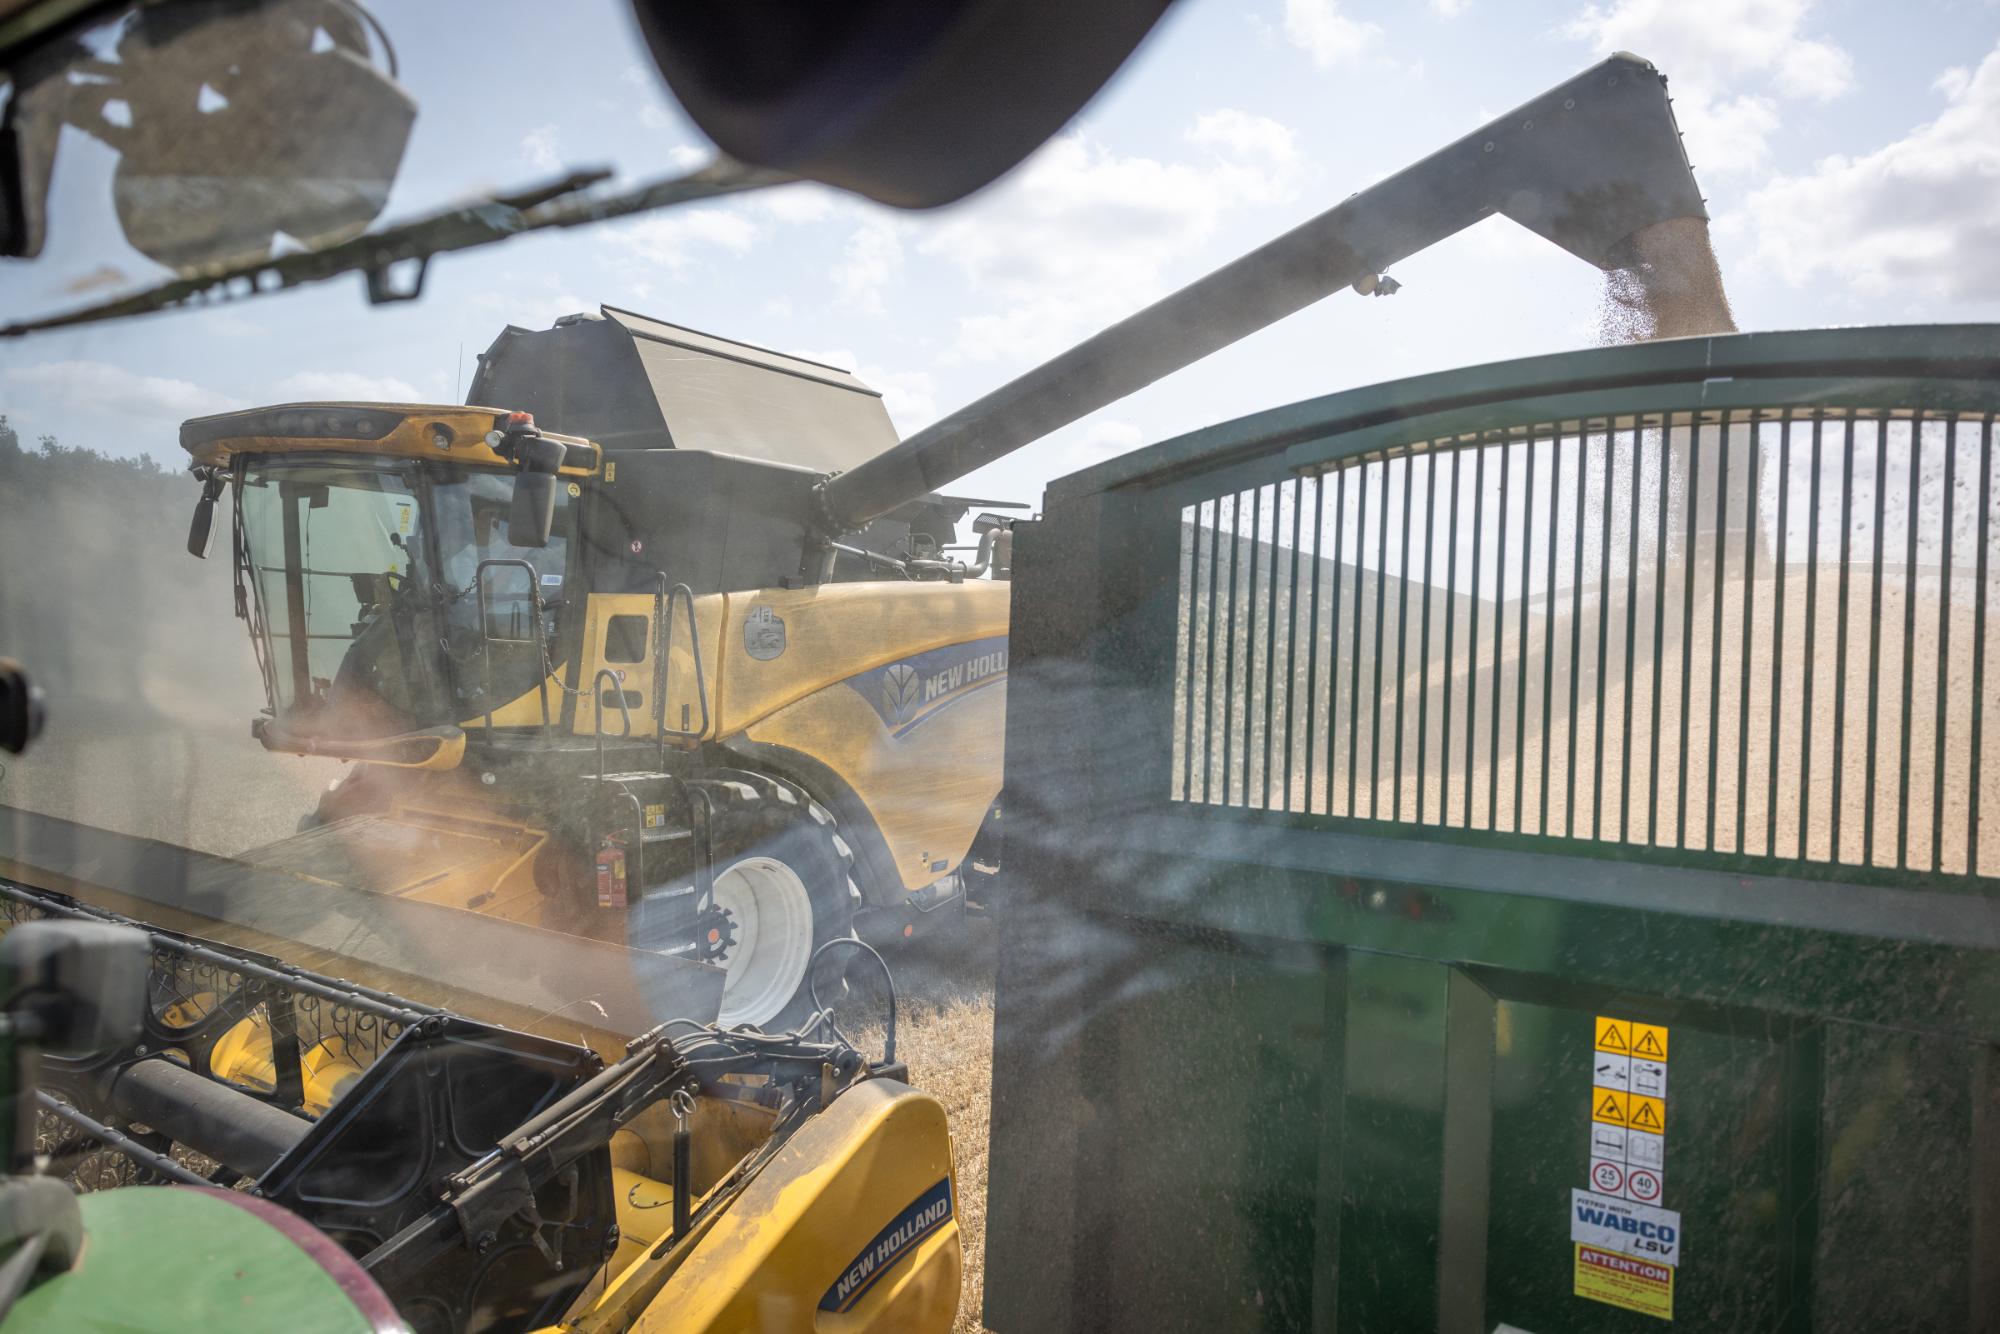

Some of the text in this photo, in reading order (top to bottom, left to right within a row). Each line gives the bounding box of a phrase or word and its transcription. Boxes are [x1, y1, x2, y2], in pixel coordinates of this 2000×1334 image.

[925, 664, 963, 702] NEW
[1600, 1168, 1616, 1181] 25
[1636, 1176, 1652, 1190] 40
[1577, 1198, 1632, 1216] FITTED WITH
[1577, 1206, 1675, 1243] WABCO
[837, 1199, 948, 1301] NEW HOLLAND
[1634, 1238, 1673, 1255] LSV
[1581, 1250, 1668, 1281] ATTENTION
